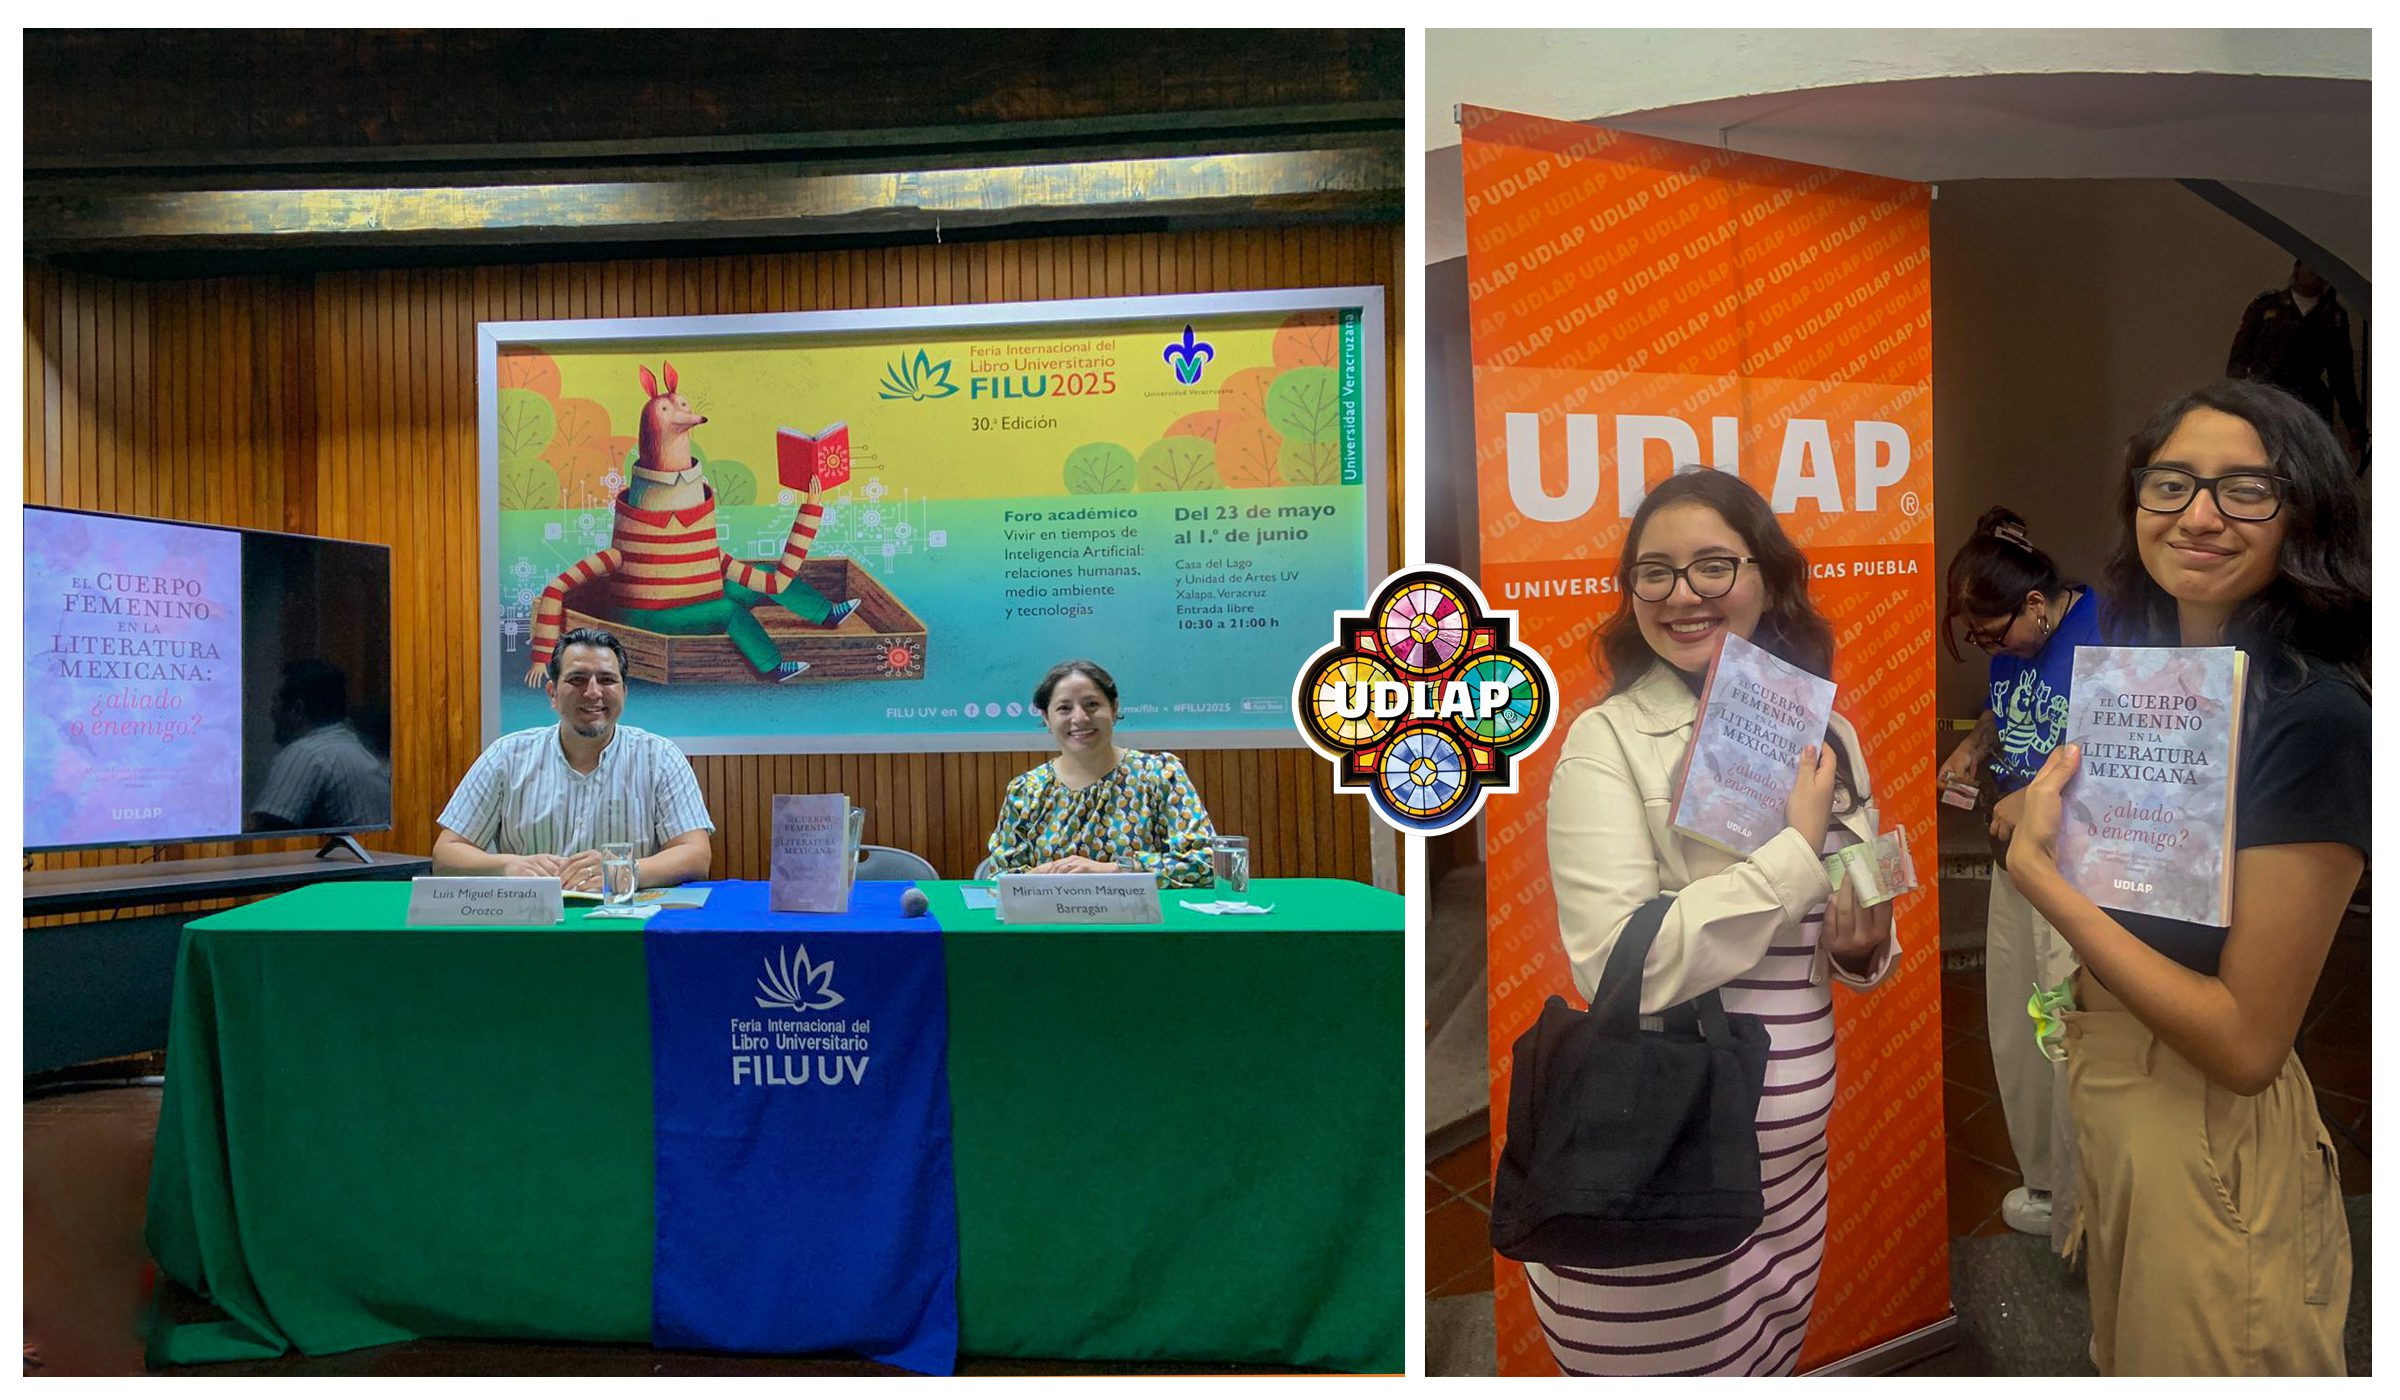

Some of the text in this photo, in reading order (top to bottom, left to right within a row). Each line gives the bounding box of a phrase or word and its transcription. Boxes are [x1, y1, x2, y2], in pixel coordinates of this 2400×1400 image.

[1483, 160, 1551, 205] UDLAP
[1652, 157, 1712, 200] UDLAP
[1589, 191, 1650, 233] UDLAP
[1740, 188, 1793, 227] UDLAP
[1684, 218, 1738, 261] UDLAP
[1820, 215, 1868, 254] UDLAP
[1520, 226, 1586, 271] UDLAP
[1893, 245, 1930, 278] UDLA
[1622, 253, 1681, 296] UDLAP
[1768, 245, 1819, 285] UDLAP
[1469, 261, 1519, 301] DLAP
[1845, 271, 1891, 308] UDLAP
[1555, 288, 1619, 334] UDLAP
[1713, 278, 1766, 318] UDLAP
[1652, 311, 1710, 356] UDLAP
[1795, 302, 1844, 341] UDLAP
[970, 340, 1116, 357] Feria Internacional del
[1486, 326, 1554, 373] UDLAP
[1869, 322, 1914, 361] UDLAP
[970, 356, 1116, 373] Libro Universitario
[1741, 334, 1794, 376] UDLAP
[1590, 348, 1649, 394] UDLAP
[1819, 354, 1869, 395] UDLAP
[1342, 314, 1357, 480] Universidad Veracruzana
[1683, 369, 1739, 413] UDLAP
[1539, 386, 1588, 427] DLAP
[1766, 387, 1818, 430] UDLAP
[1002, 415, 1057, 430] Edición
[1004, 507, 1138, 523] Foro académico
[1175, 504, 1336, 521] Del 23 de mayo
[1004, 526, 1138, 542] Vivir en tiempos de
[1175, 530, 1191, 544] al
[1225, 529, 1250, 542] de
[1256, 527, 1309, 545] junio
[1004, 545, 1144, 563] Inteligencia Artificial:
[1175, 558, 1252, 570] Casa del Lago
[1005, 567, 1073, 579] relaciones
[1176, 571, 1299, 588] y Unidad de Artes UV
[1807, 560, 1918, 579] ICAS PUEBLA
[72, 572, 201, 597] EL CUERPO
[1005, 584, 1115, 598] medio ambiente
[1218, 588, 1267, 599] Veracruz
[1506, 576, 1618, 599] UNIVERSI
[63, 594, 210, 621] FEMENINO
[1005, 608, 1013, 620] y
[1176, 603, 1254, 615] Entrada libre
[118, 621, 160, 634] EN LA
[1178, 617, 1279, 630] 10:30 a 21:00 h
[52, 635, 221, 660] LITERATURA
[1886, 628, 1932, 671] UDLAP
[59, 659, 213, 682] MEXICANA:
[90, 687, 183, 715] ¿aliado
[1751, 682, 1805, 717] CUERPO
[1837, 666, 1884, 711] UDLAP
[886, 707, 957, 718] FILU UV en
[1174, 703, 1231, 714] #FILU2025
[1732, 687, 1806, 732] FEMENINO
[2100, 694, 2198, 711] EL CUERPO
[69, 715, 202, 743] o enemigo?
[2092, 711, 2203, 731] FEMENINO
[1723, 726, 1797, 769] MEXICANA
[2129, 732, 2162, 743] EN LA
[2082, 742, 2209, 766] LITERATURA
[1728, 761, 1778, 791] ¿aliado
[1883, 755, 1928, 799] UDLAP
[2089, 762, 2199, 785] MEXICANA
[112, 807, 162, 820] UDLAP
[2103, 801, 2174, 824] ¿aliado
[1726, 820, 1753, 839] UDLAP
[2088, 825, 2189, 852] o enemigo?
[433, 888, 537, 901] Luis Miguel Estrada
[1013, 885, 1146, 898] Miriam Yvonn Márquez
[2114, 879, 2153, 894] UDLAP
[461, 905, 503, 916] Orozco
[1056, 903, 1108, 916] Barragán
[1860, 970, 1904, 1019] UDLAP
[731, 1018, 870, 1033] Feria Internacional del
[1881, 1010, 1928, 1058] UDLAP
[732, 1033, 868, 1050] Libro Universitario
[732, 1054, 870, 1086] FILU UV
